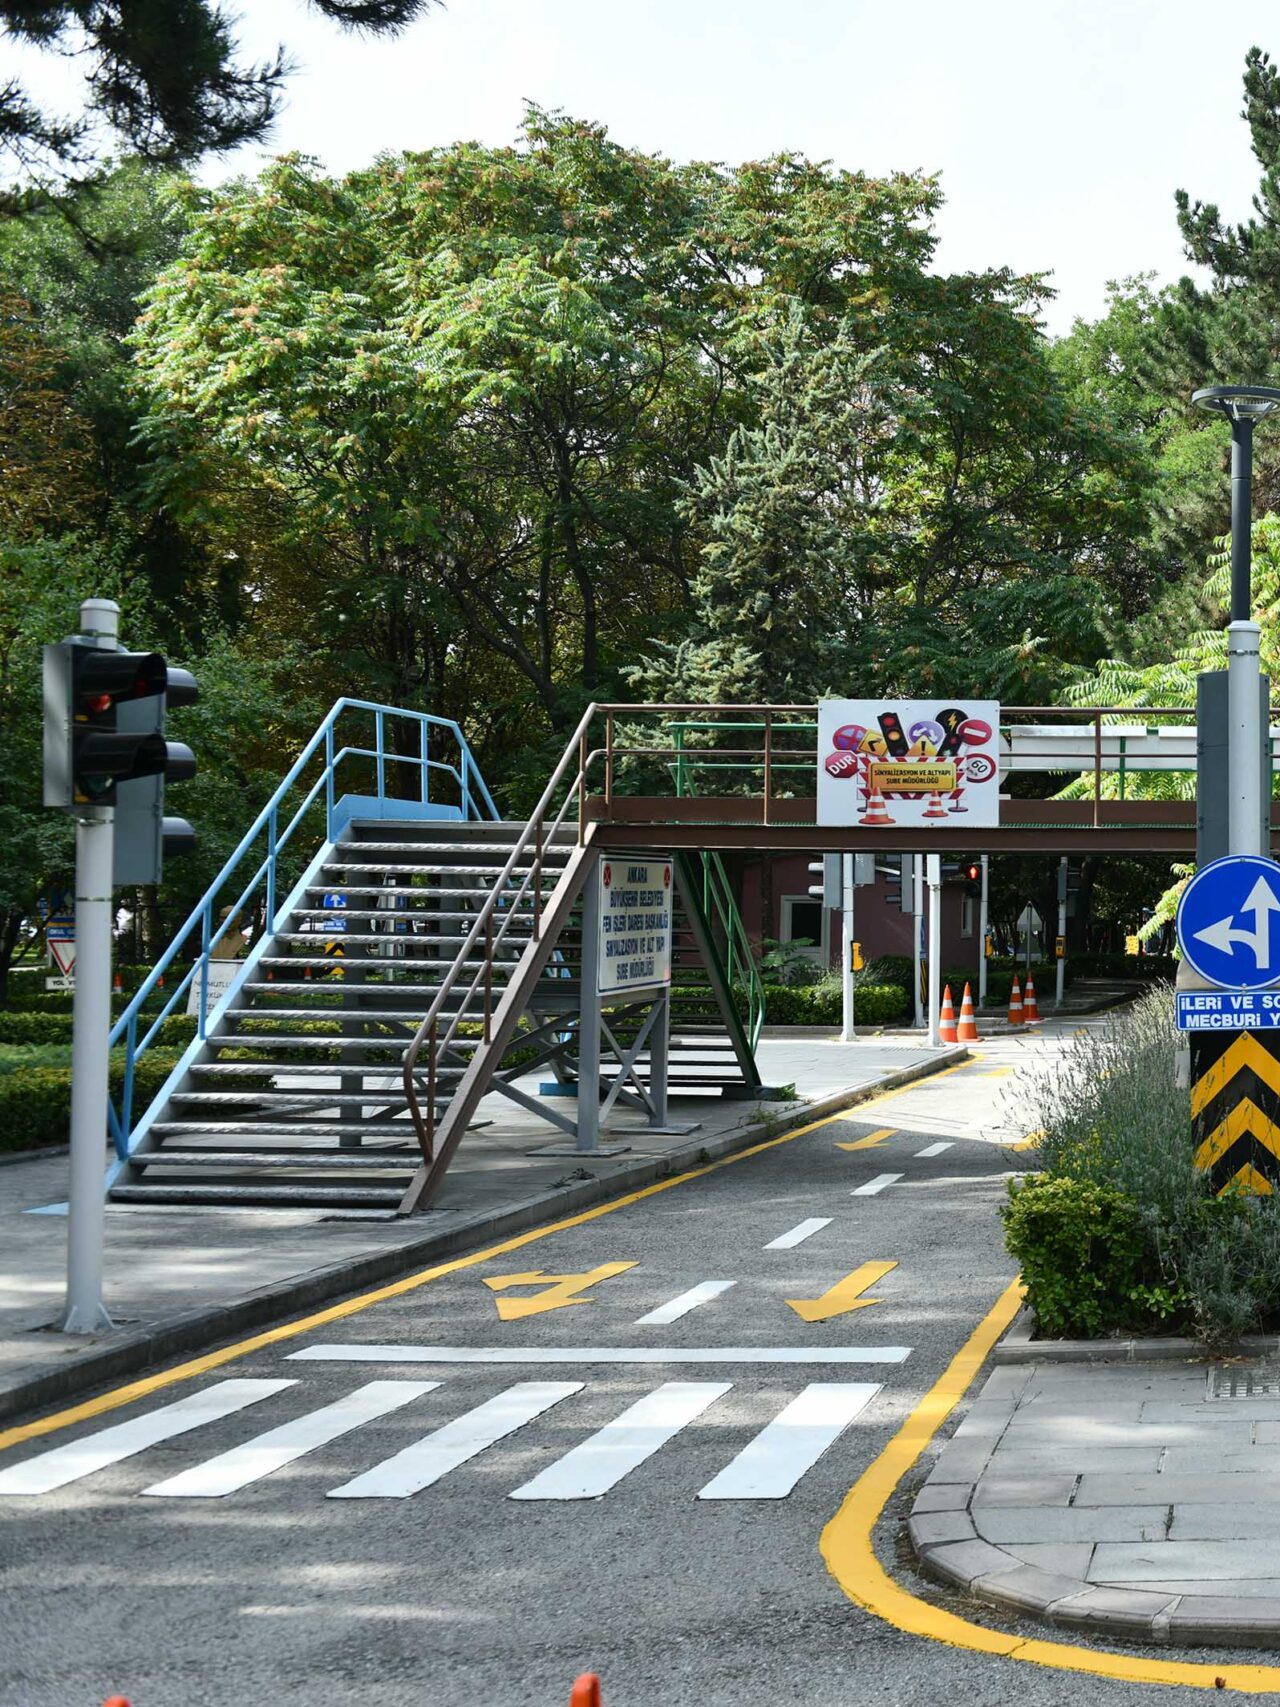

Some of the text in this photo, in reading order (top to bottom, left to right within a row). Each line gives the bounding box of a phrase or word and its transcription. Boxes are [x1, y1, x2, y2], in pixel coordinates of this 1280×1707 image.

[828, 754, 856, 775] DUR
[971, 759, 988, 773] 60
[1230, 995, 1254, 1009] VE
